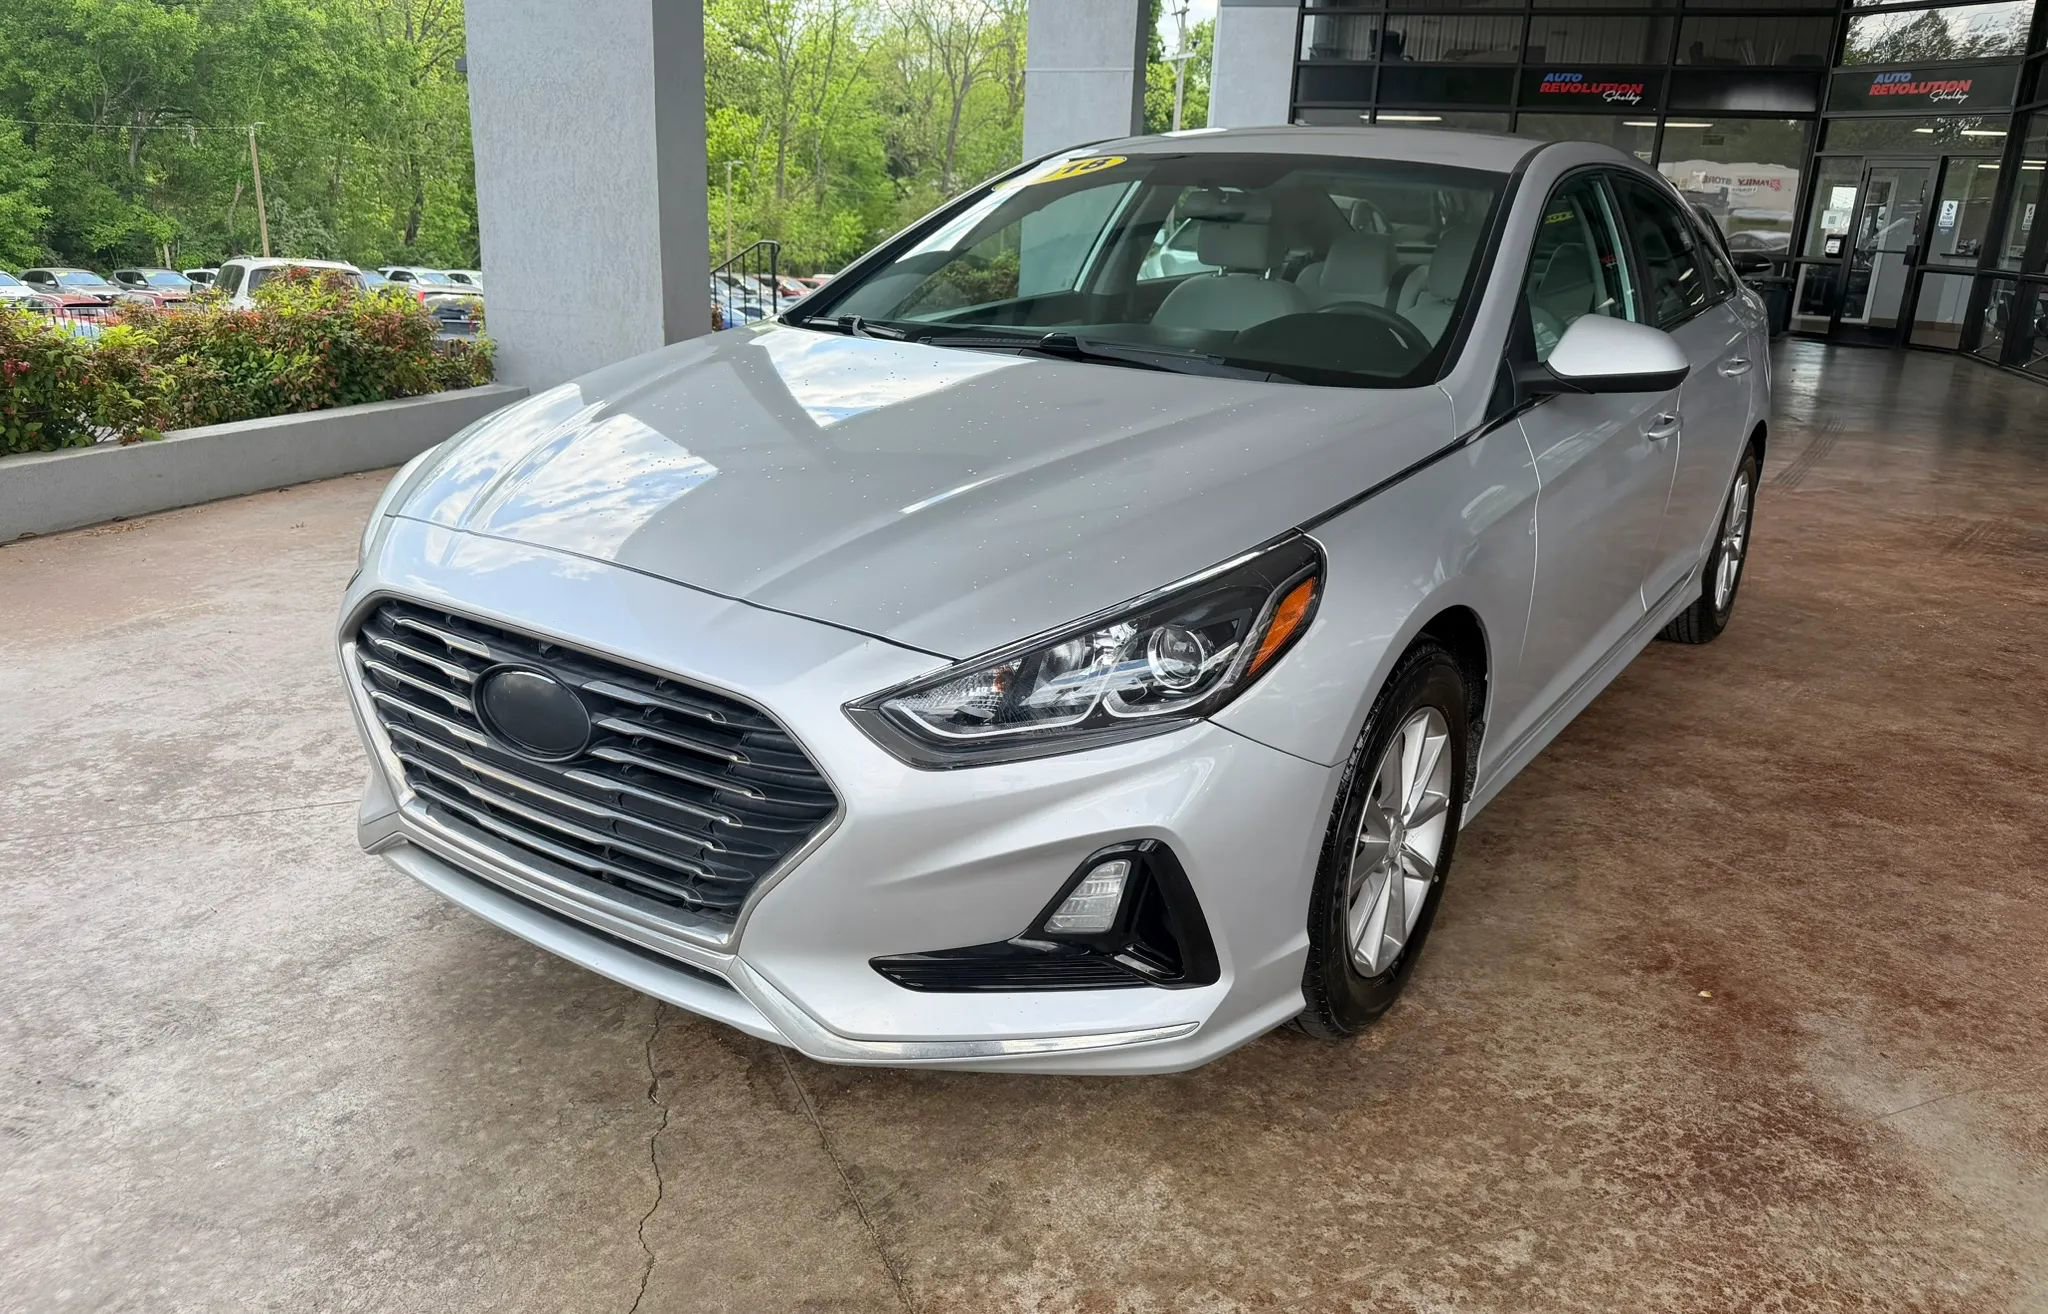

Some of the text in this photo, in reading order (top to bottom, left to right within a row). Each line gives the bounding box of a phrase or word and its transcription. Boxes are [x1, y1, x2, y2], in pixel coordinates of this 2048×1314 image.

[1544, 73, 1583, 82] AUTO
[1873, 72, 1912, 84] AUTO
[1539, 83, 1644, 94] REVOLUTION
[1869, 80, 1973, 96] REVOLUTION
[1602, 90, 1642, 105] Shelby
[1929, 88, 1969, 104] Shelby
